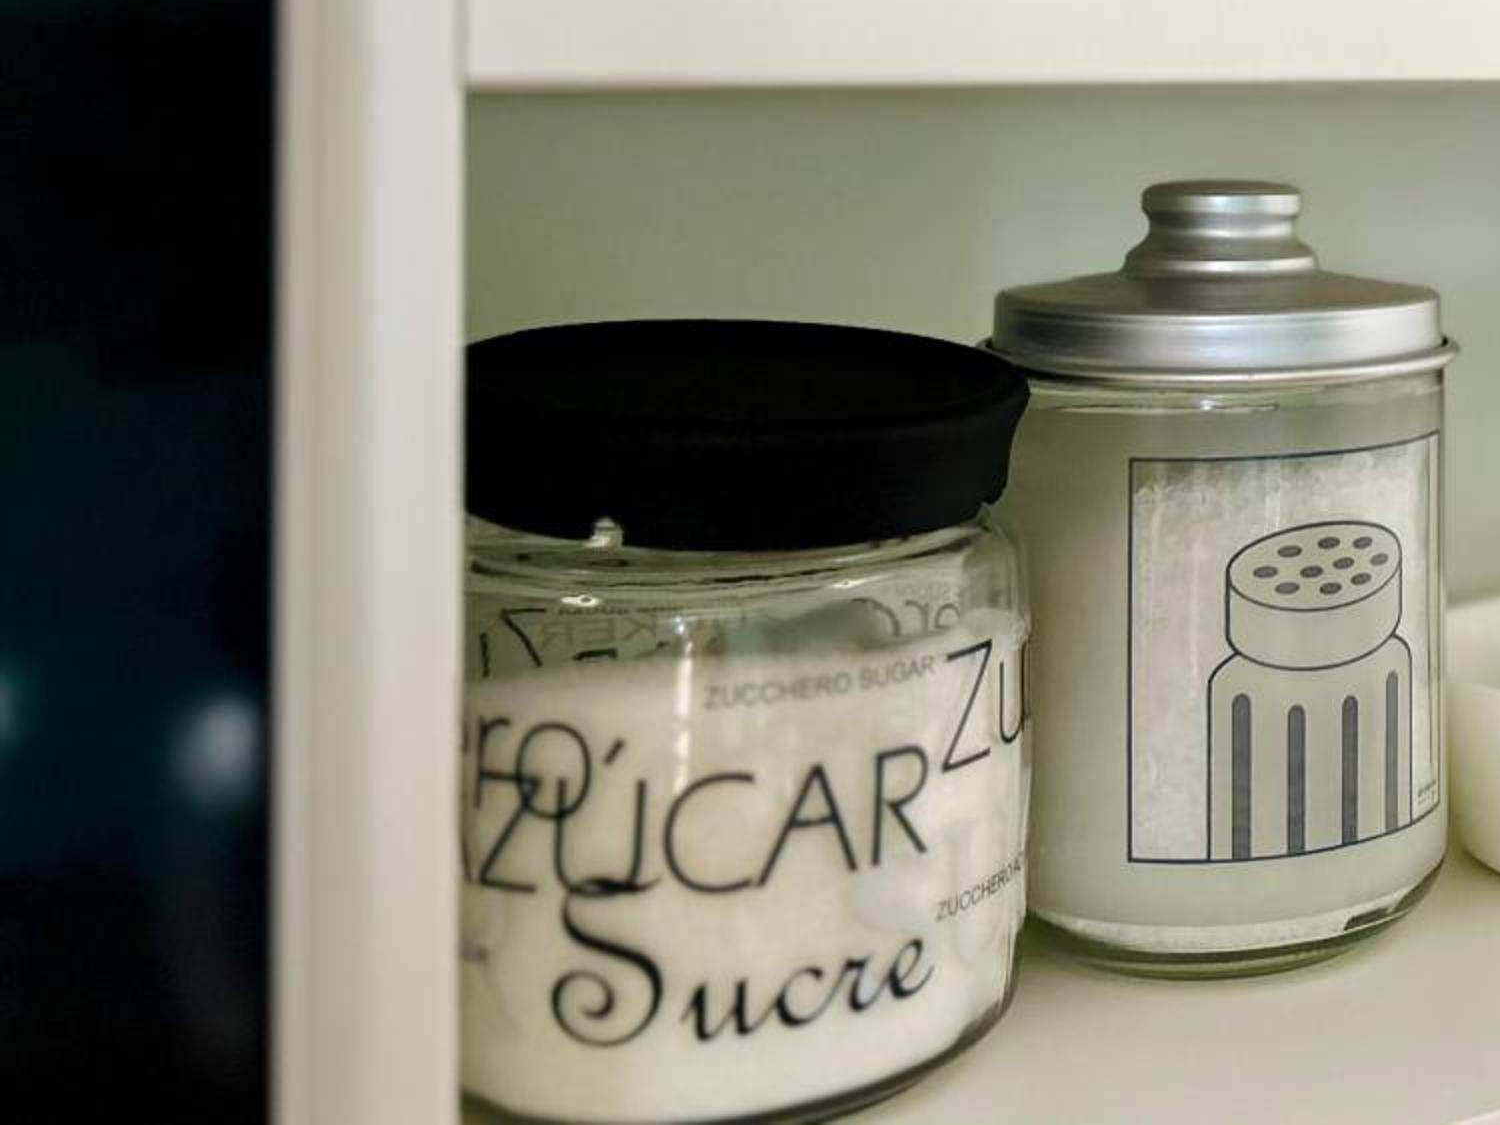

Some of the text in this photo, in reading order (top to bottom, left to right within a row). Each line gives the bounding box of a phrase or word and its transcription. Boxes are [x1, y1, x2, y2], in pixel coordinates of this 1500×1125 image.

[703, 654, 936, 712] ZUCCHERO SUGAR
[550, 876, 935, 1047] Sucre
